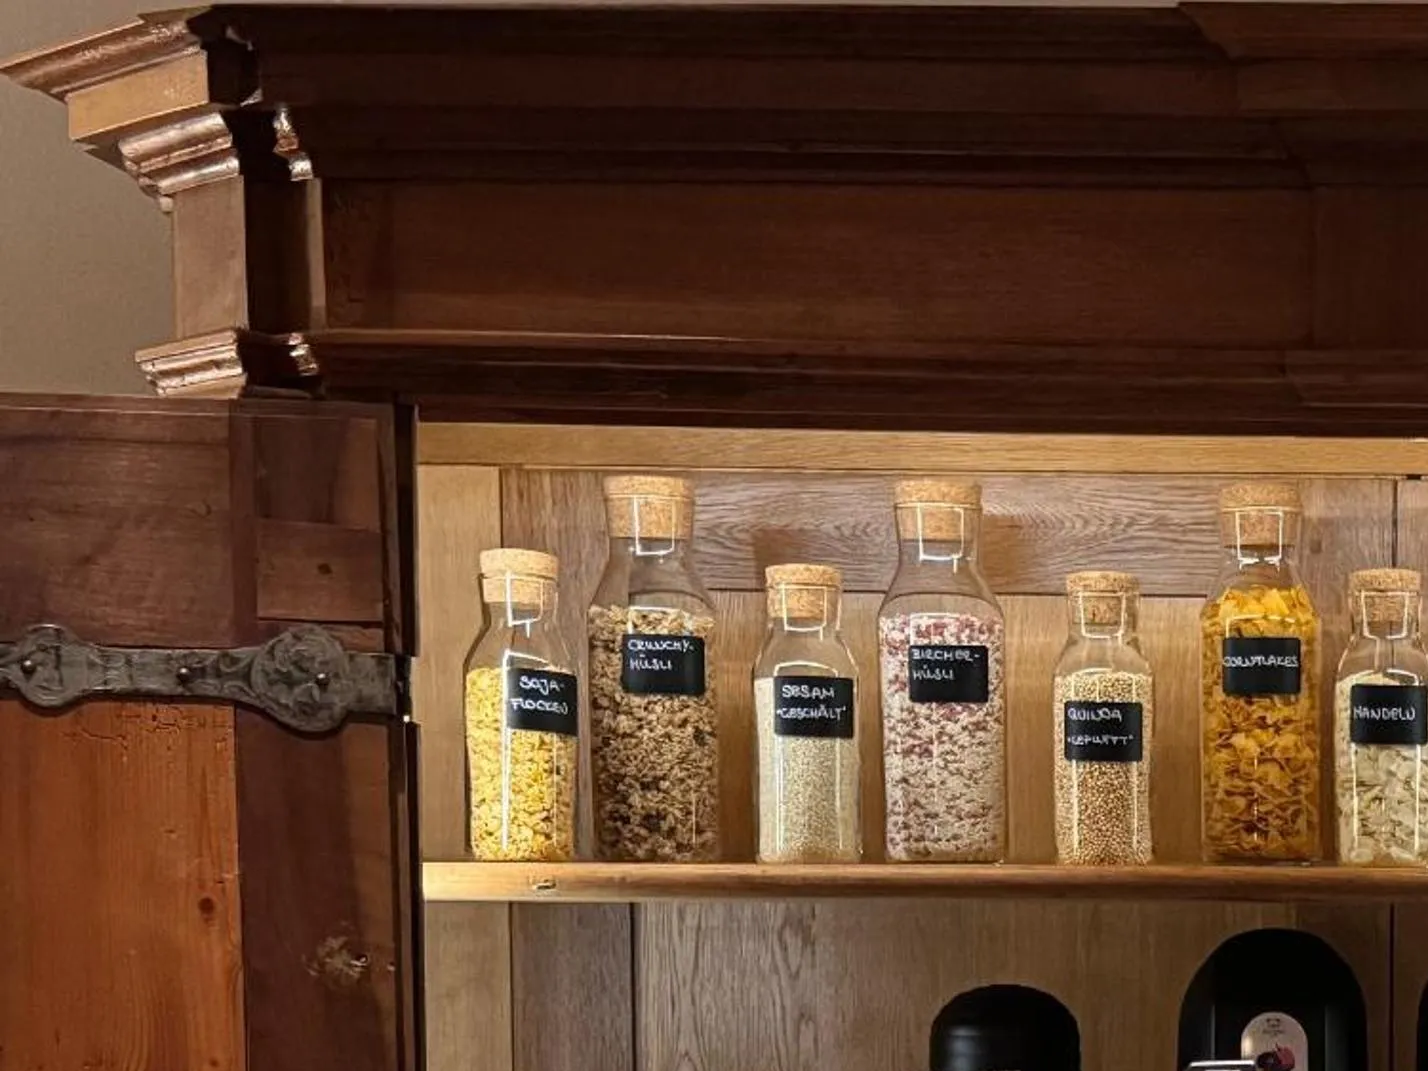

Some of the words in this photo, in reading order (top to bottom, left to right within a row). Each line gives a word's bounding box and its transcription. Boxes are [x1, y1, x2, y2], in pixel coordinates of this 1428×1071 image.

[781, 684, 835, 700] SESAM
[1067, 707, 1123, 722] QUINOA
[1353, 705, 1416, 721] MANDELN
